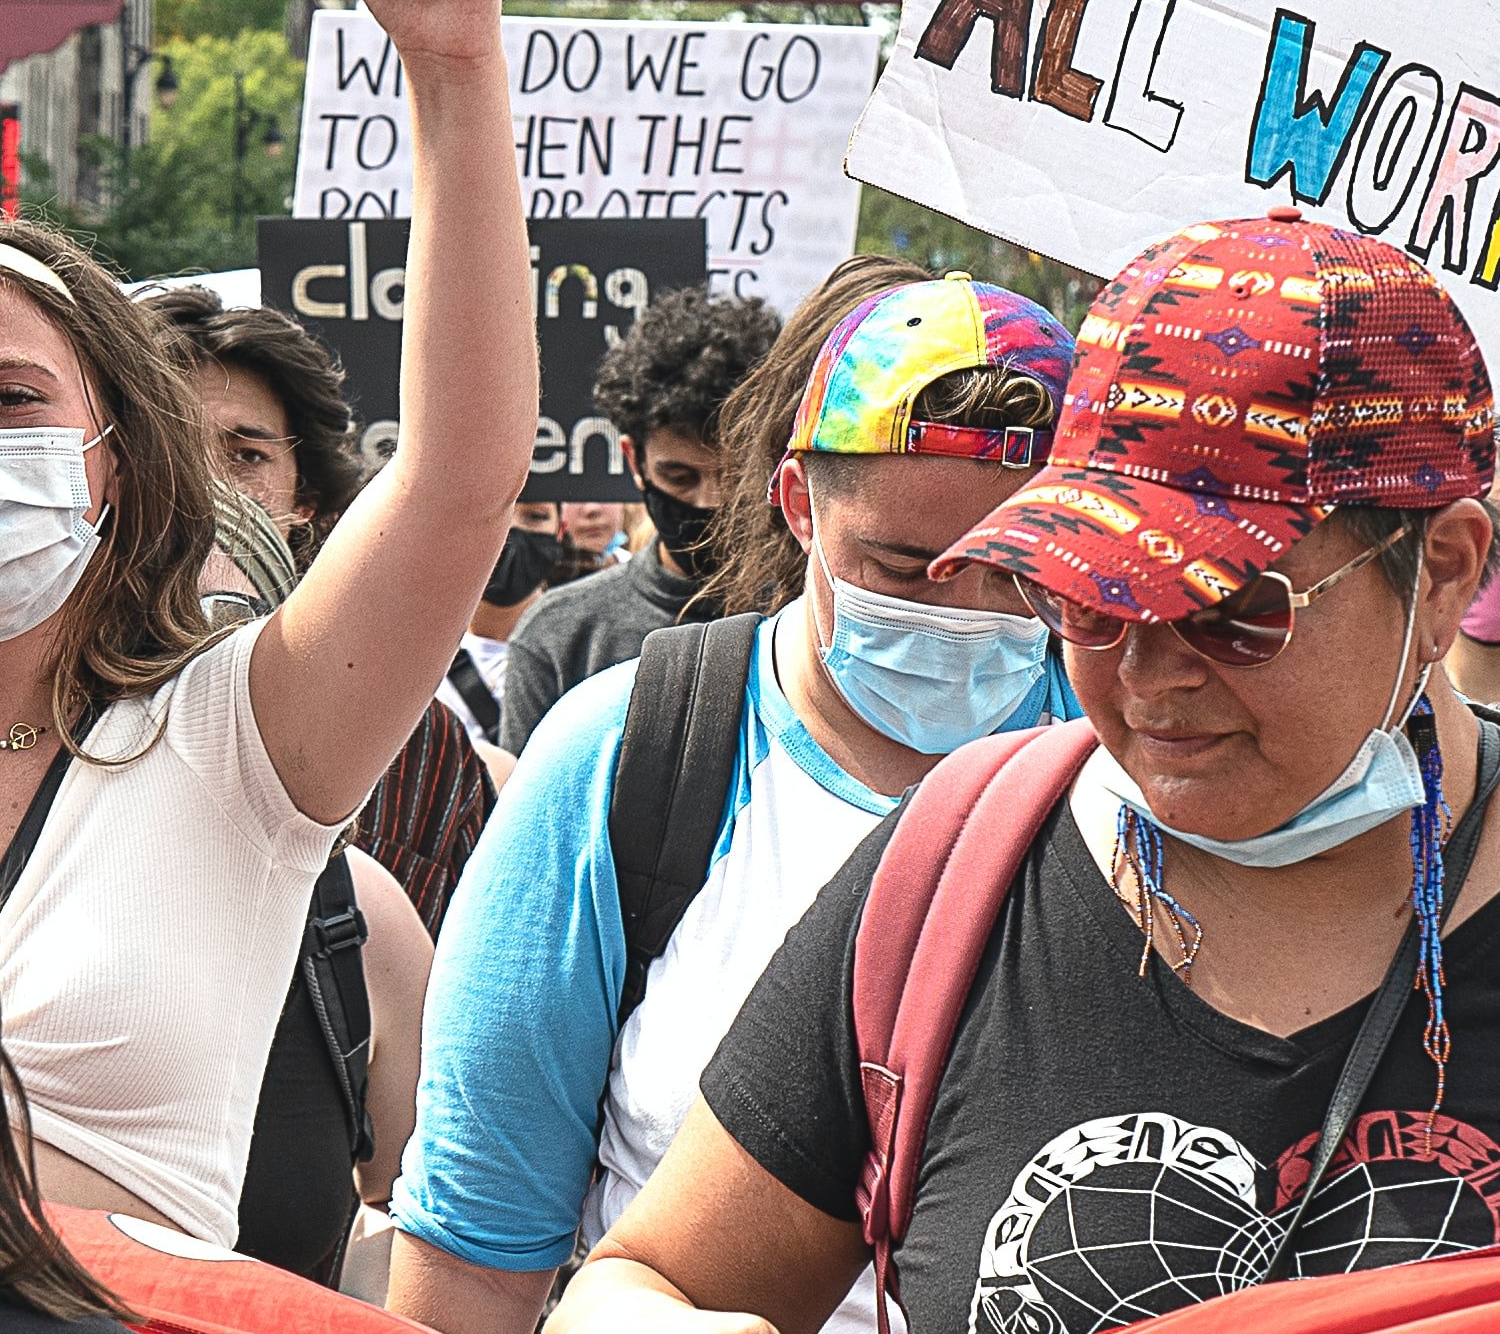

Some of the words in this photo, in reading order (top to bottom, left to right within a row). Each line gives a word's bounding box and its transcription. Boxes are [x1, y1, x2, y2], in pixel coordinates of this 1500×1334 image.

[520, 28, 602, 96] DO
[625, 32, 707, 97] WE
[739, 32, 822, 104] GO
[319, 114, 399, 171] TO
[514, 114, 615, 180] HEN
[636, 114, 755, 175] THE
